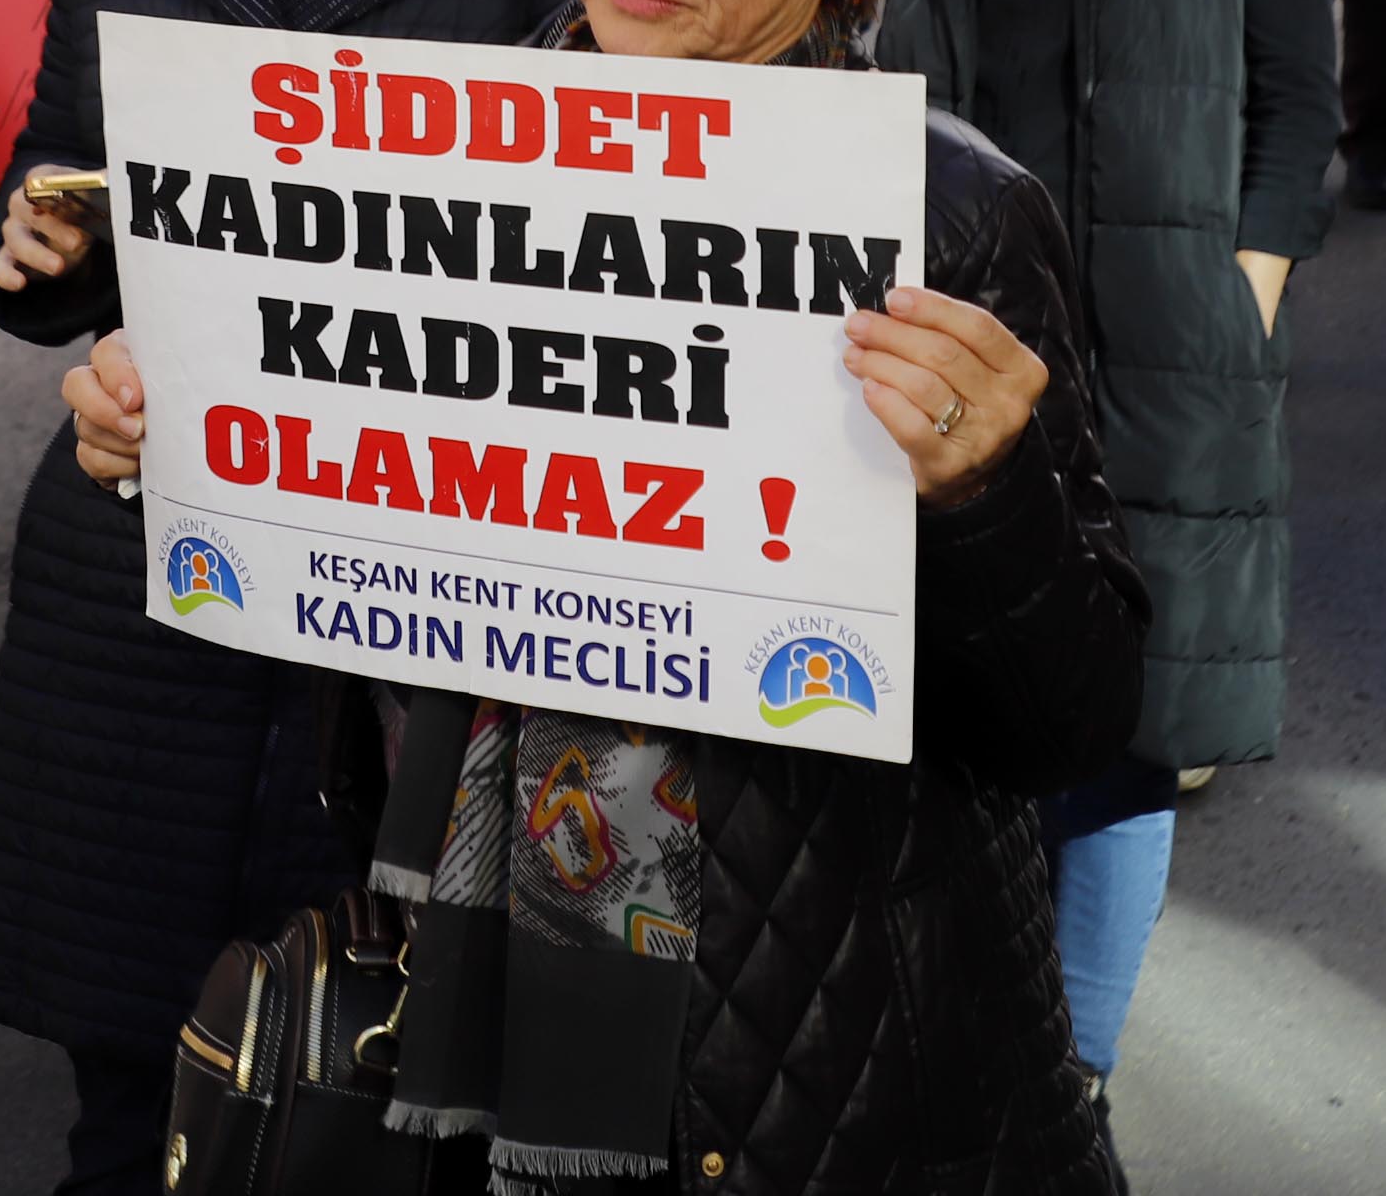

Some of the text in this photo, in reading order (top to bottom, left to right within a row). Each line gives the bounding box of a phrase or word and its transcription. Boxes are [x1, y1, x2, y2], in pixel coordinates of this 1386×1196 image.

[250, 48, 732, 180] ŞİDDET
[126, 160, 902, 317] KADINLARIN
[257, 296, 730, 430] KADERİ
[204, 405, 705, 552] OLAMAZ
[176, 517, 208, 535] KENT
[210, 527, 257, 592] KONSEYİ
[308, 550, 694, 638] KEŞAN KENT KONSEYİ
[295, 593, 711, 703] KADIN MECLİSİ
[744, 616, 896, 694] KEŞAN KENT KONSEYİ
